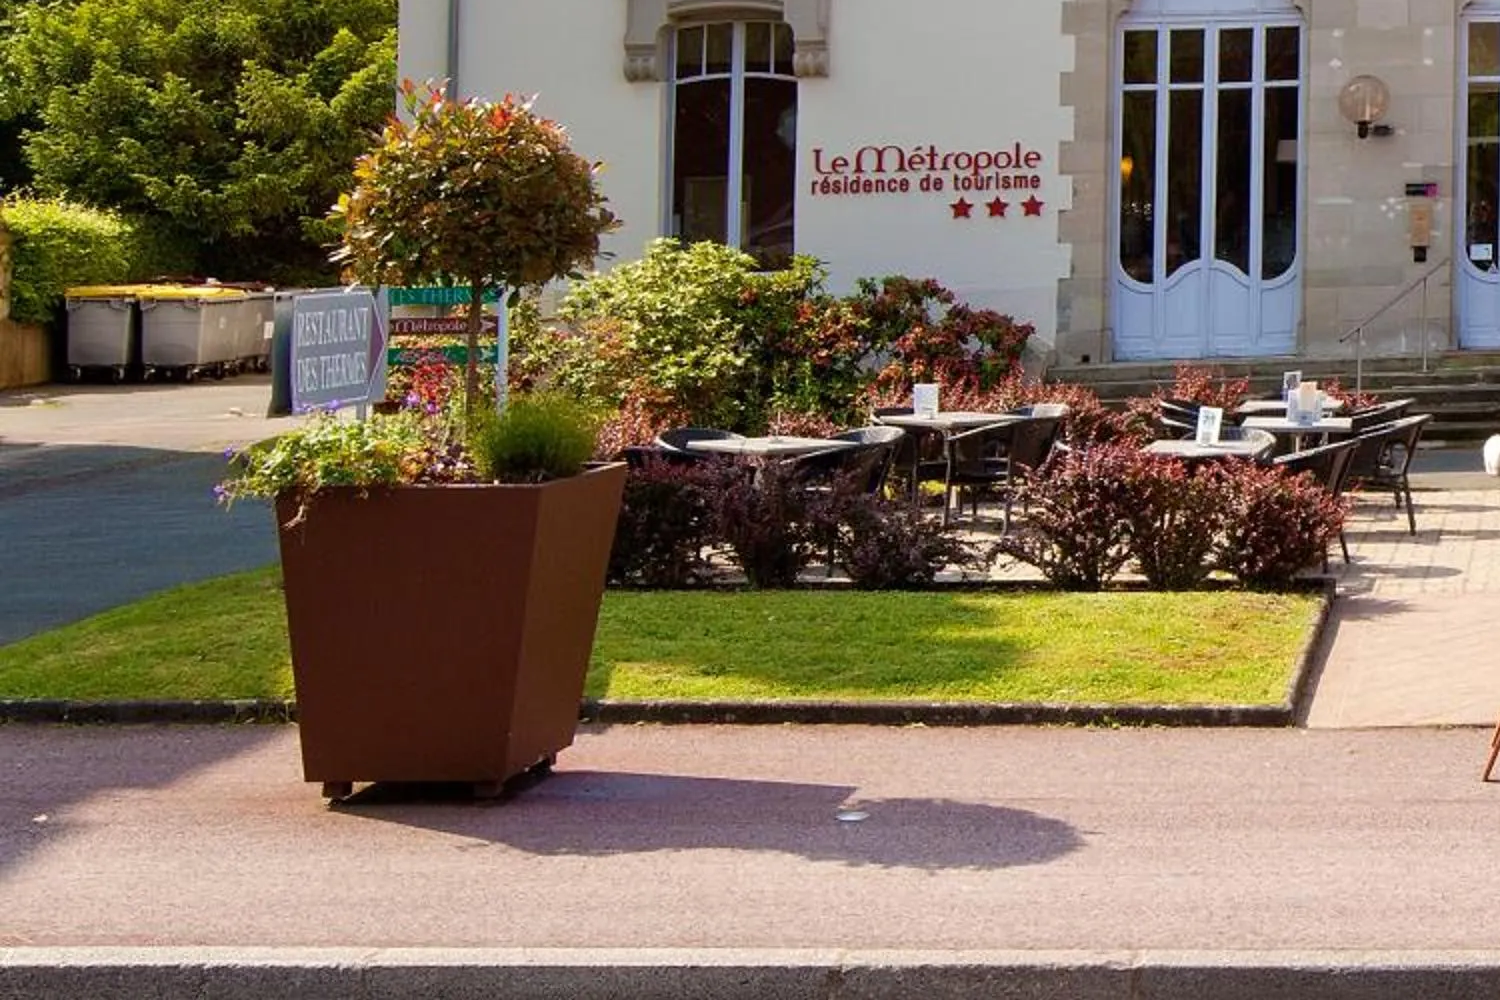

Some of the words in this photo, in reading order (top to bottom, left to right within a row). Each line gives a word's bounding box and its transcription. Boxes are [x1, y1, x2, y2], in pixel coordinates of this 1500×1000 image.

[812, 148, 849, 174] Le
[854, 142, 1042, 176] Métropole
[811, 174, 910, 195] résidence
[919, 173, 944, 191] de
[953, 172, 1041, 191] tourisme
[296, 307, 369, 347] RESTAURANT
[297, 357, 318, 393] DES
